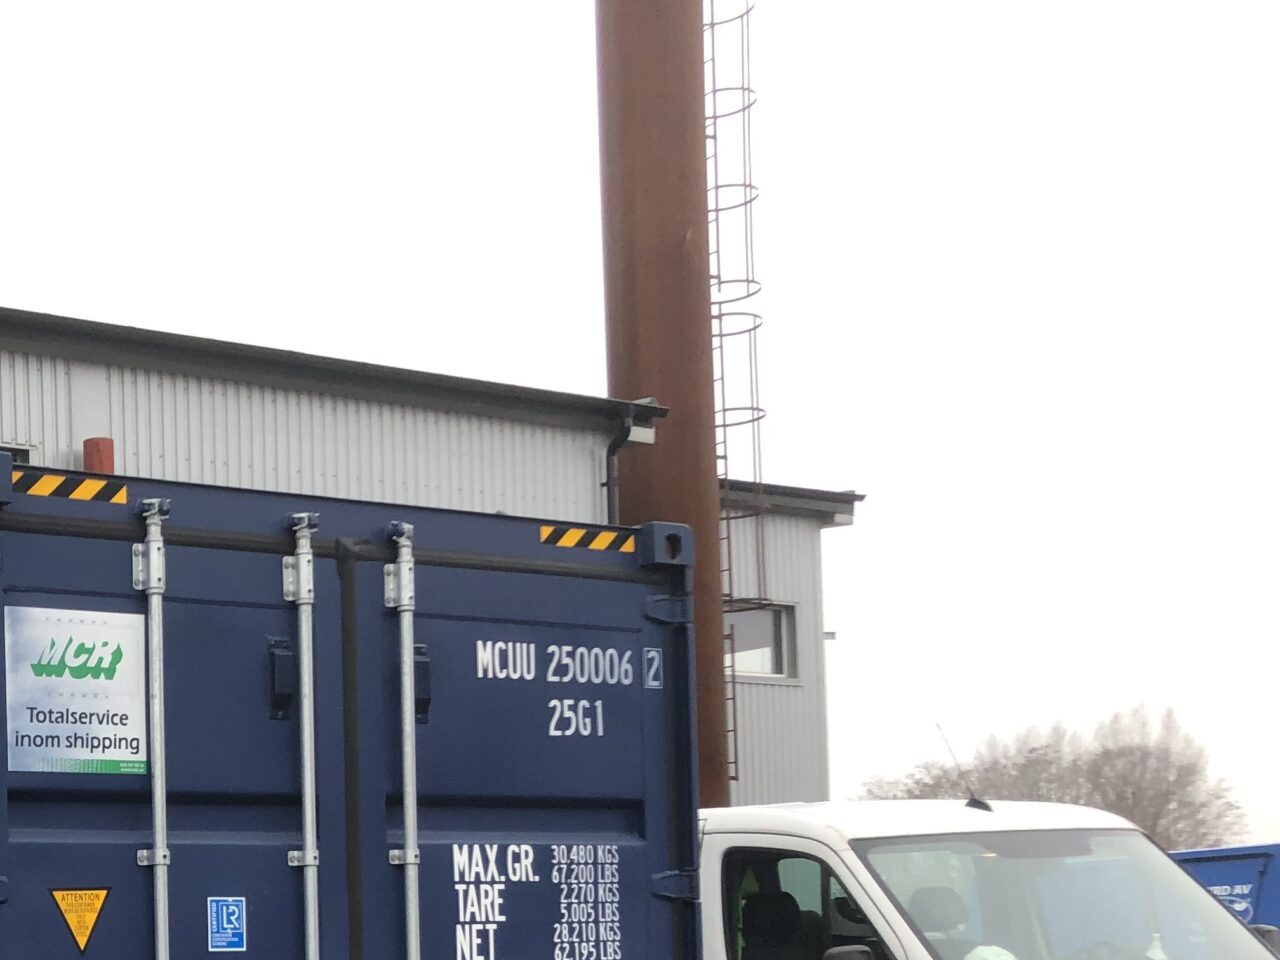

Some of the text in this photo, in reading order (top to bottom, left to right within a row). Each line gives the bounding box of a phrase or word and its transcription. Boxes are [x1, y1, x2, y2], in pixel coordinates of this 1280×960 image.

[30, 636, 124, 680] MCR
[476, 640, 662, 687] MCUU 250006 2
[26, 706, 129, 726] Totalservice
[547, 699, 604, 737] 25G1
[14, 730, 140, 755] inom shipping
[597, 845, 619, 863] KGS
[597, 864, 619, 883] LBS
[61, 892, 100, 901] ATTENTION
[597, 884, 620, 902] KGS
[454, 884, 507, 922] TARE
[598, 903, 620, 922] LBS
[222, 905, 240, 928] LR
[599, 923, 621, 942] KGS
[600, 942, 622, 960] LBS
